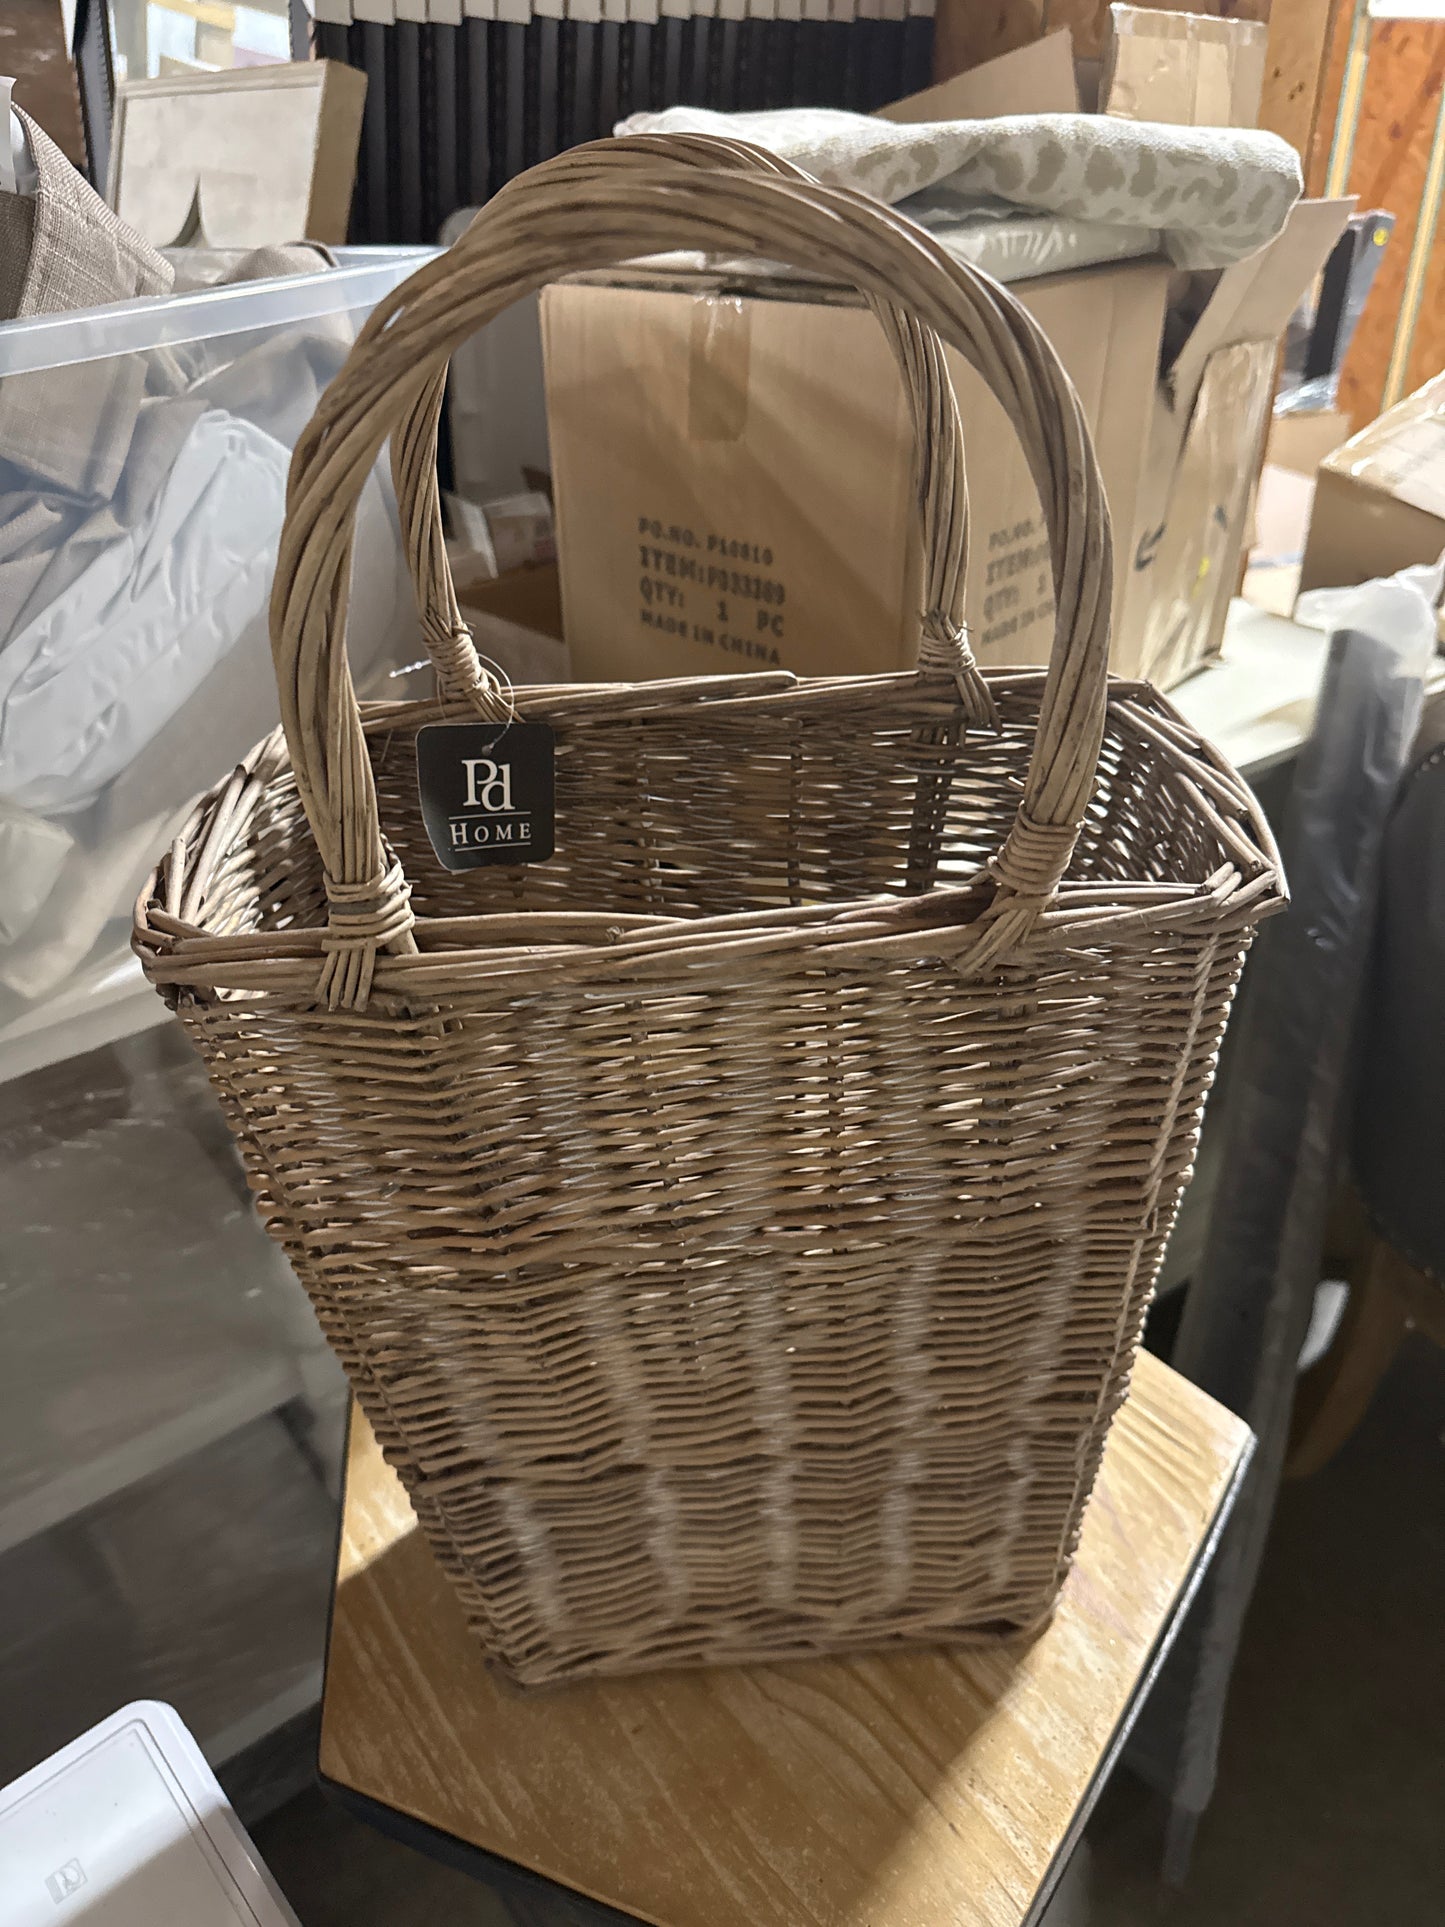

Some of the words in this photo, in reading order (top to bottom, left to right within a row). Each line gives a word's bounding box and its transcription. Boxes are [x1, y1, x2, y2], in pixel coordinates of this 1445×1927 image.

[641, 576, 684, 608] QTY:
[757, 610, 784, 637] PC
[641, 609, 687, 637] MADE
[693, 625, 714, 644] IN
[719, 634, 780, 665] CHINA
[462, 759, 515, 811] Pd
[450, 823, 531, 845] HOME
